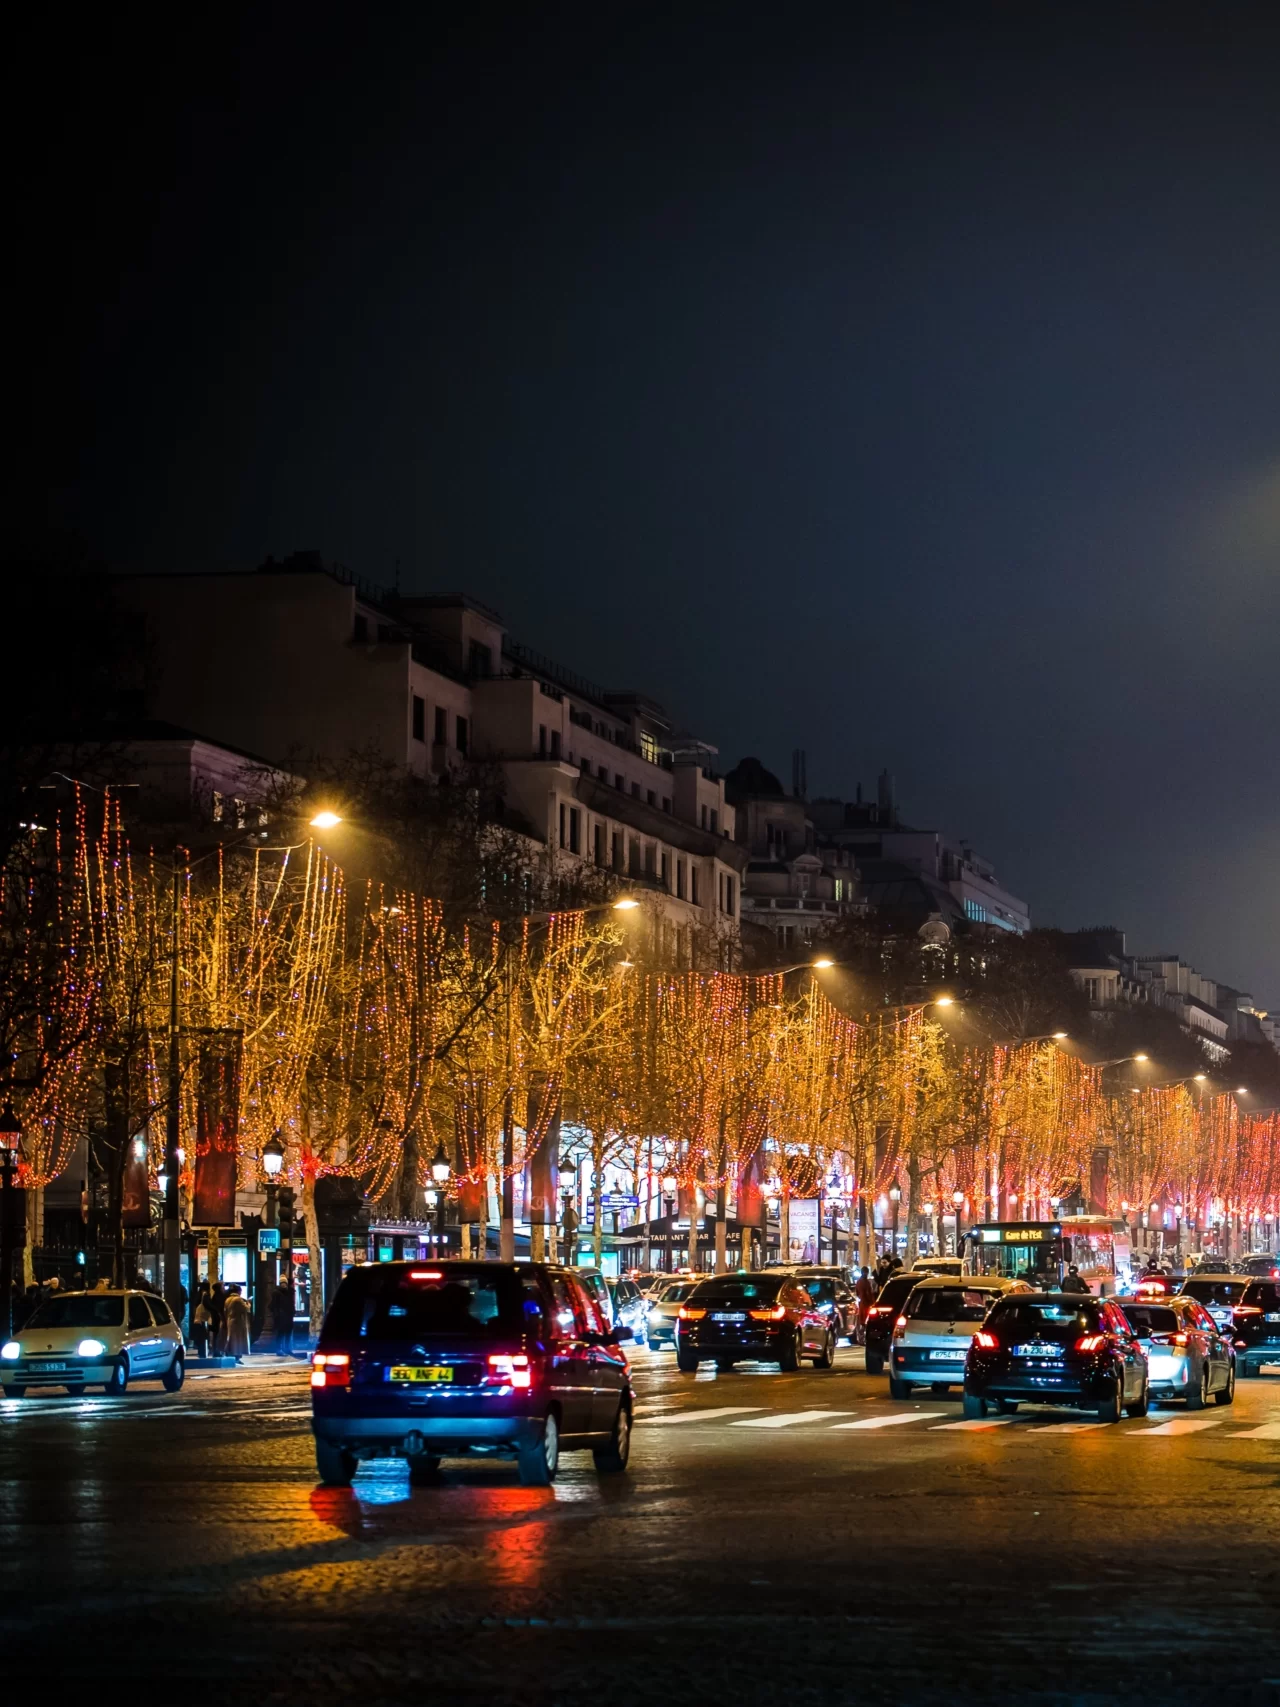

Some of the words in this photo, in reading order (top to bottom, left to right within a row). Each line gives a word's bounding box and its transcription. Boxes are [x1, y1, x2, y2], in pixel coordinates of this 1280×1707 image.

[1005, 1231, 1020, 1240] Gare
[1020, 1230, 1029, 1240] de
[260, 1236, 277, 1244] TAXIS
